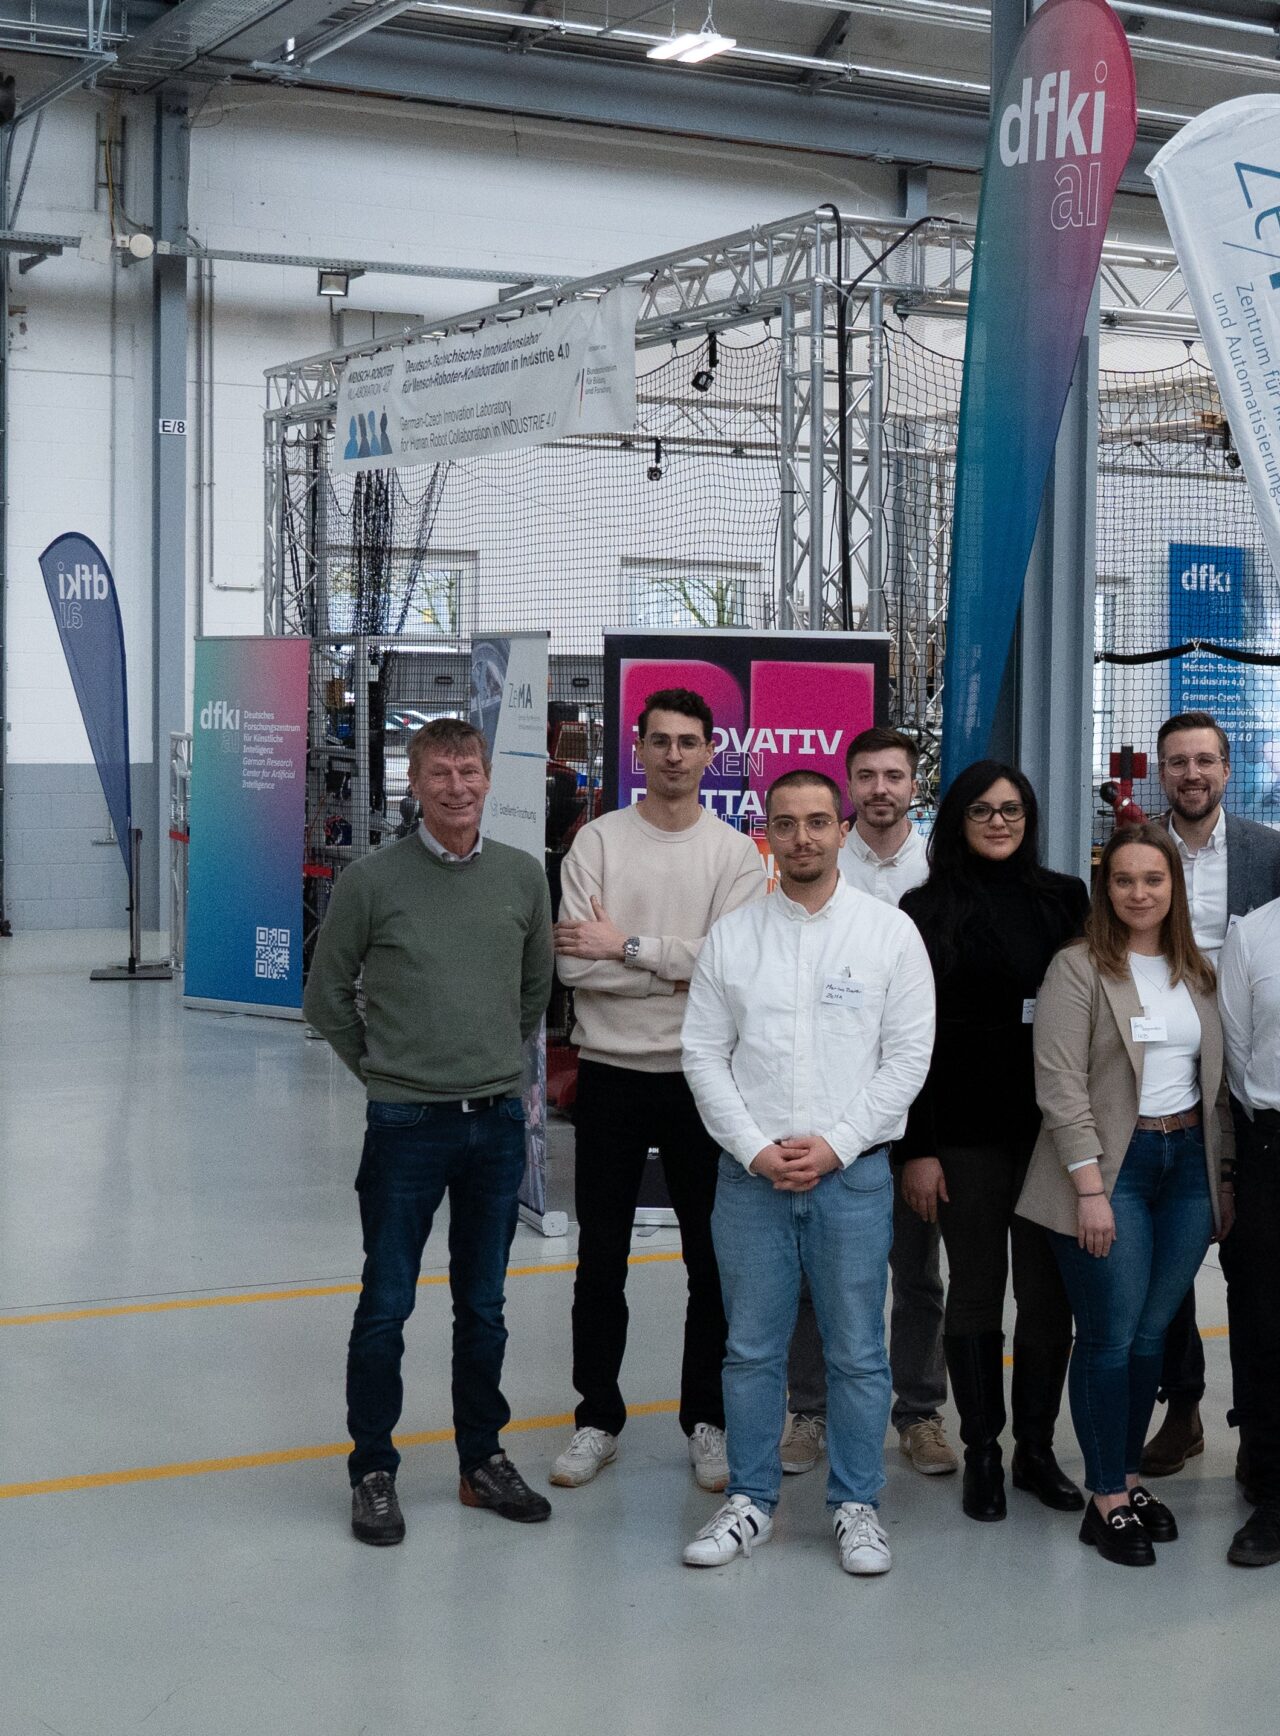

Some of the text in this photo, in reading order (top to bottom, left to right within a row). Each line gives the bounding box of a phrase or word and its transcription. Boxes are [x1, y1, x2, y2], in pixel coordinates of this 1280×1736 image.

[1000, 61, 1108, 168] dfki
[1051, 162, 1101, 231] ai
[1212, 292, 1238, 329] und
[1235, 281, 1271, 367] Zentrum
[511, 356, 519, 371] in
[520, 346, 555, 369] Industrie
[162, 420, 185, 434] E/8
[443, 405, 475, 425] Innovation
[475, 399, 512, 417] Laboratory
[448, 425, 492, 445] Collaboration
[492, 422, 500, 438] in
[500, 413, 546, 436] INDUSTRIE
[1181, 562, 1231, 593] dfki
[200, 700, 241, 731] dfki
